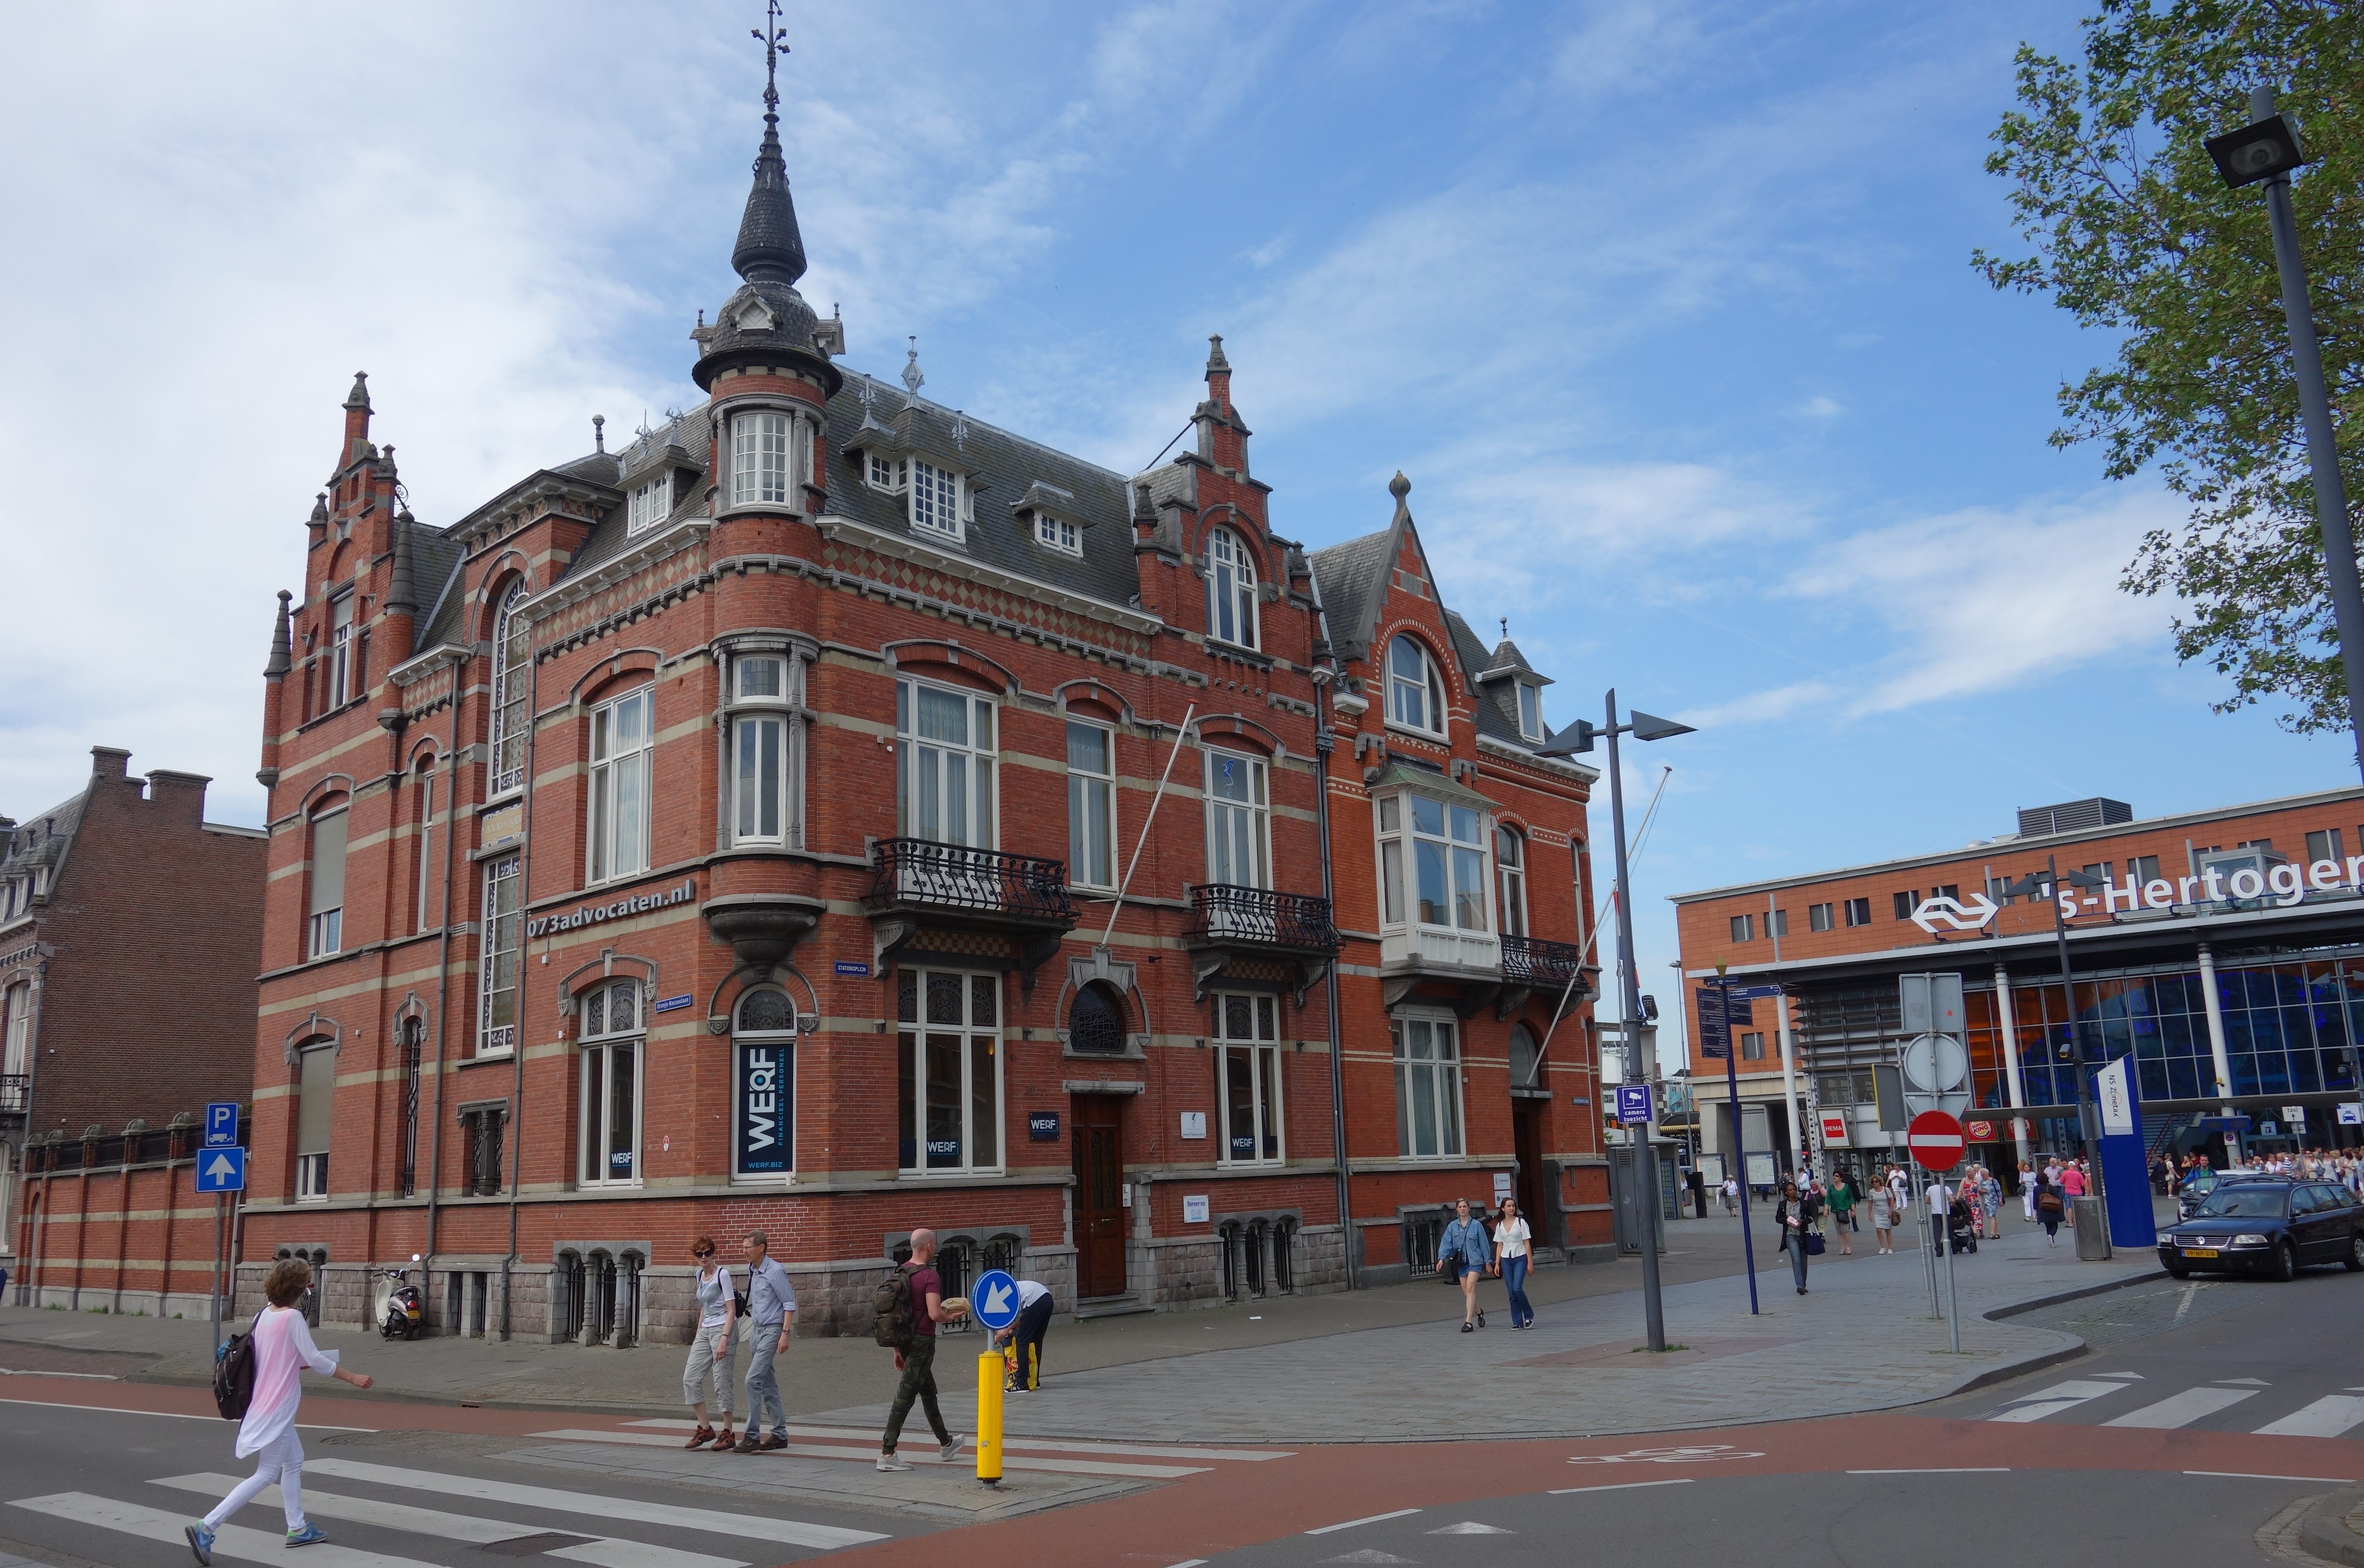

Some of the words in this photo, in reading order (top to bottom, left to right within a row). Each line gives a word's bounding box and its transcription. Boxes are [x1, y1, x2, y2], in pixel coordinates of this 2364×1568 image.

[527, 879, 693, 937] 073advocaten.nl
[669, 998, 689, 1006] Nassaulaan
[2109, 1075, 2116, 1084] NS
[749, 1048, 775, 1152] WERF
[215, 1107, 231, 1128] P
[1030, 1120, 1056, 1129] WERF
[1973, 1125, 1988, 1134] KING
[927, 1141, 956, 1152] WERF
[1232, 1138, 1253, 1147] WERF
[611, 1152, 631, 1164] WERF
